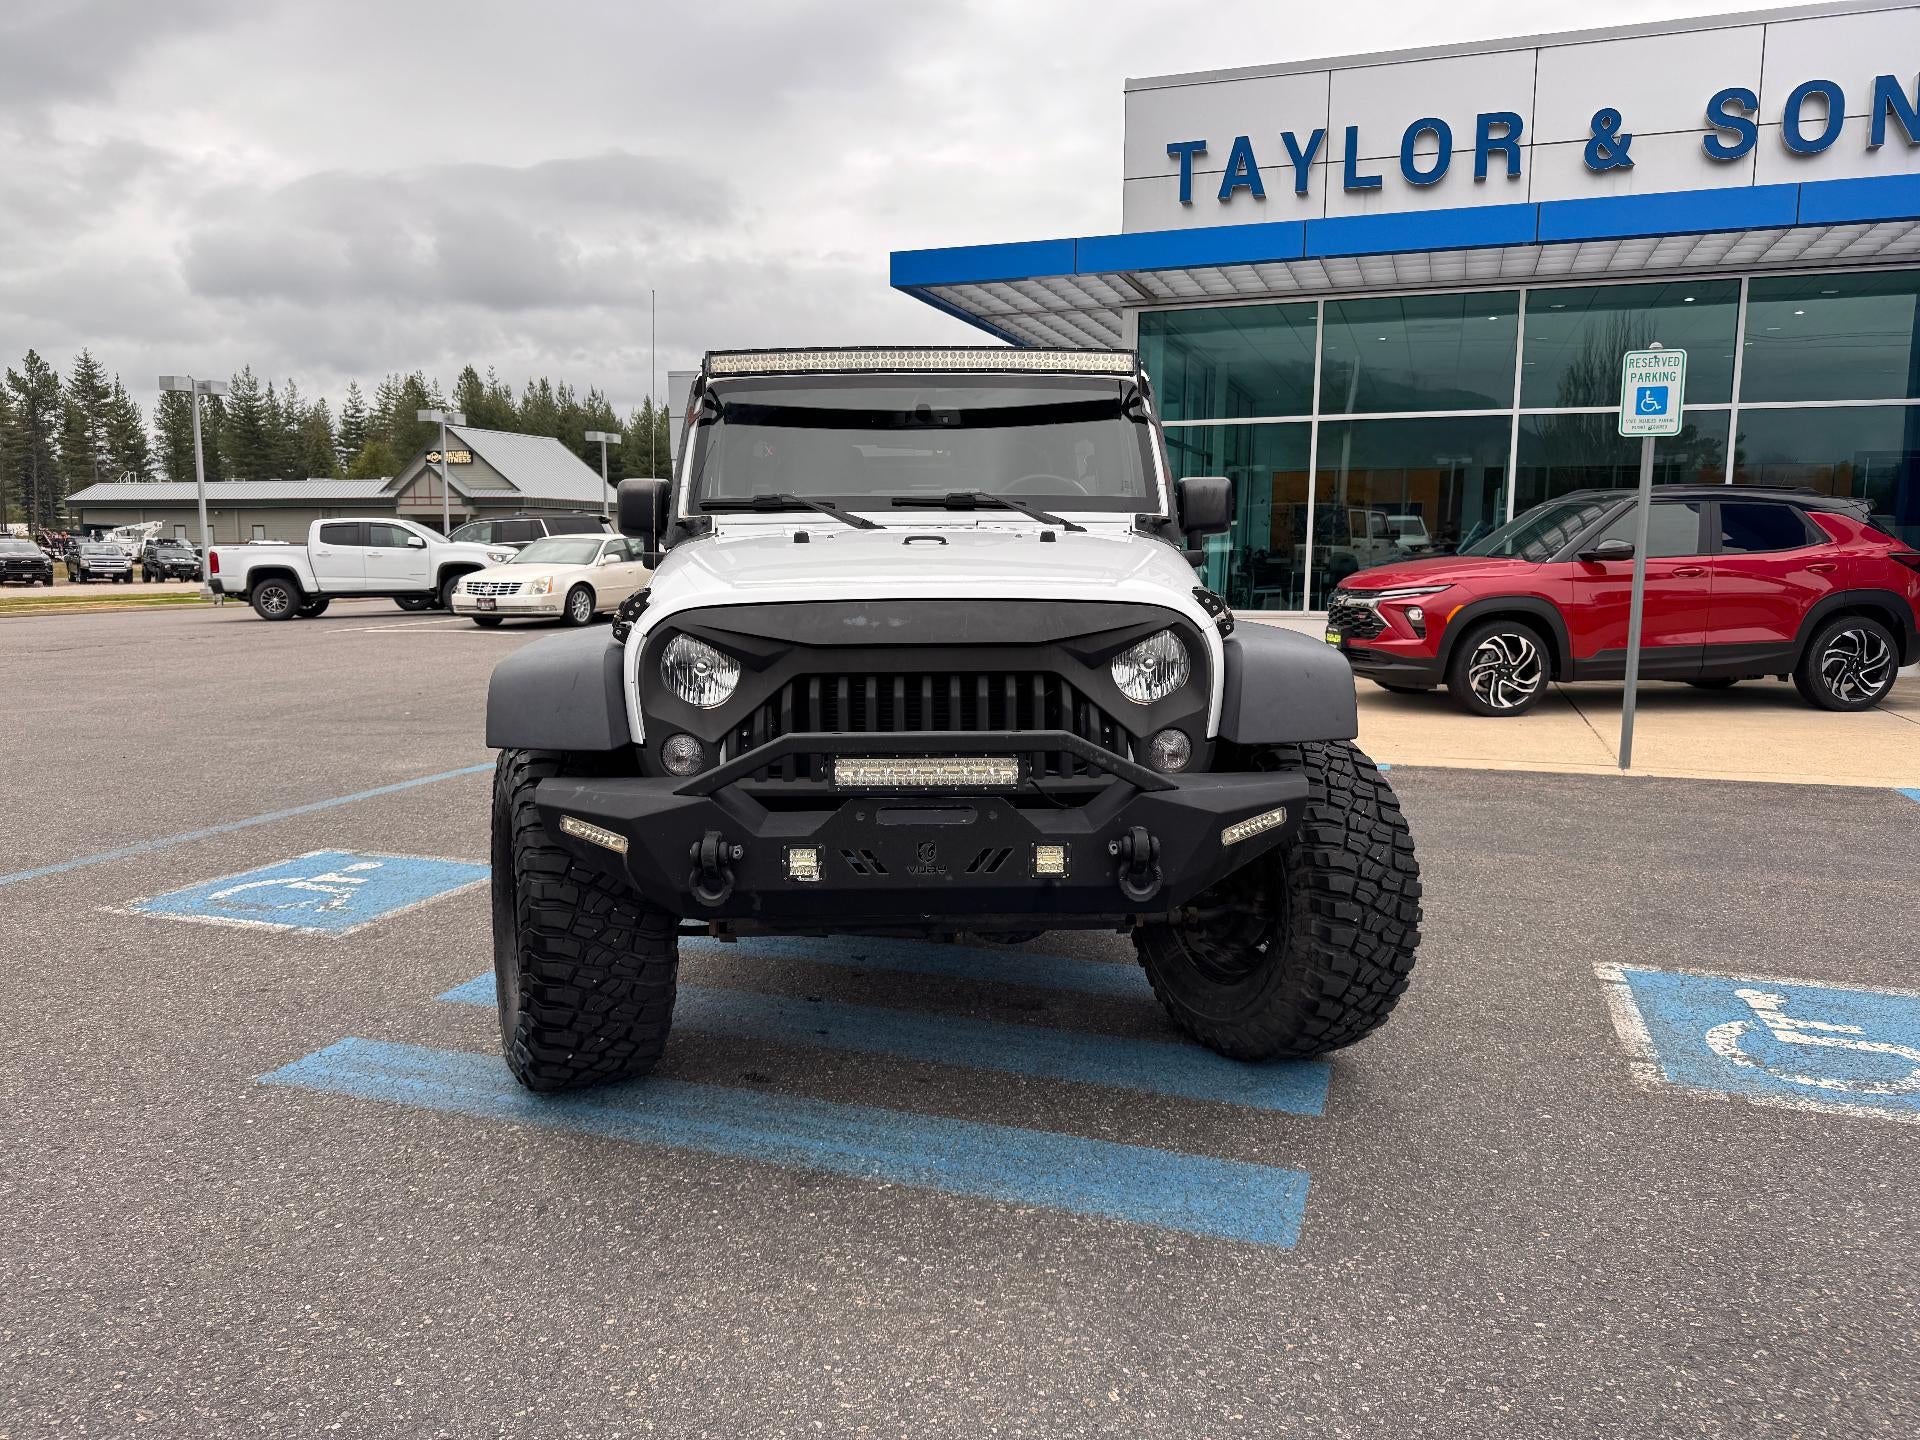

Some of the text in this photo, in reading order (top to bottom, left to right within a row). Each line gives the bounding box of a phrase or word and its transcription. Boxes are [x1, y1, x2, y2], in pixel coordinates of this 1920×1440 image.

[1166, 110, 1524, 204] TAYLOR
[1584, 107, 1635, 172] &
[1628, 357, 1680, 368] RESERVED
[1630, 372, 1676, 383] PARKING
